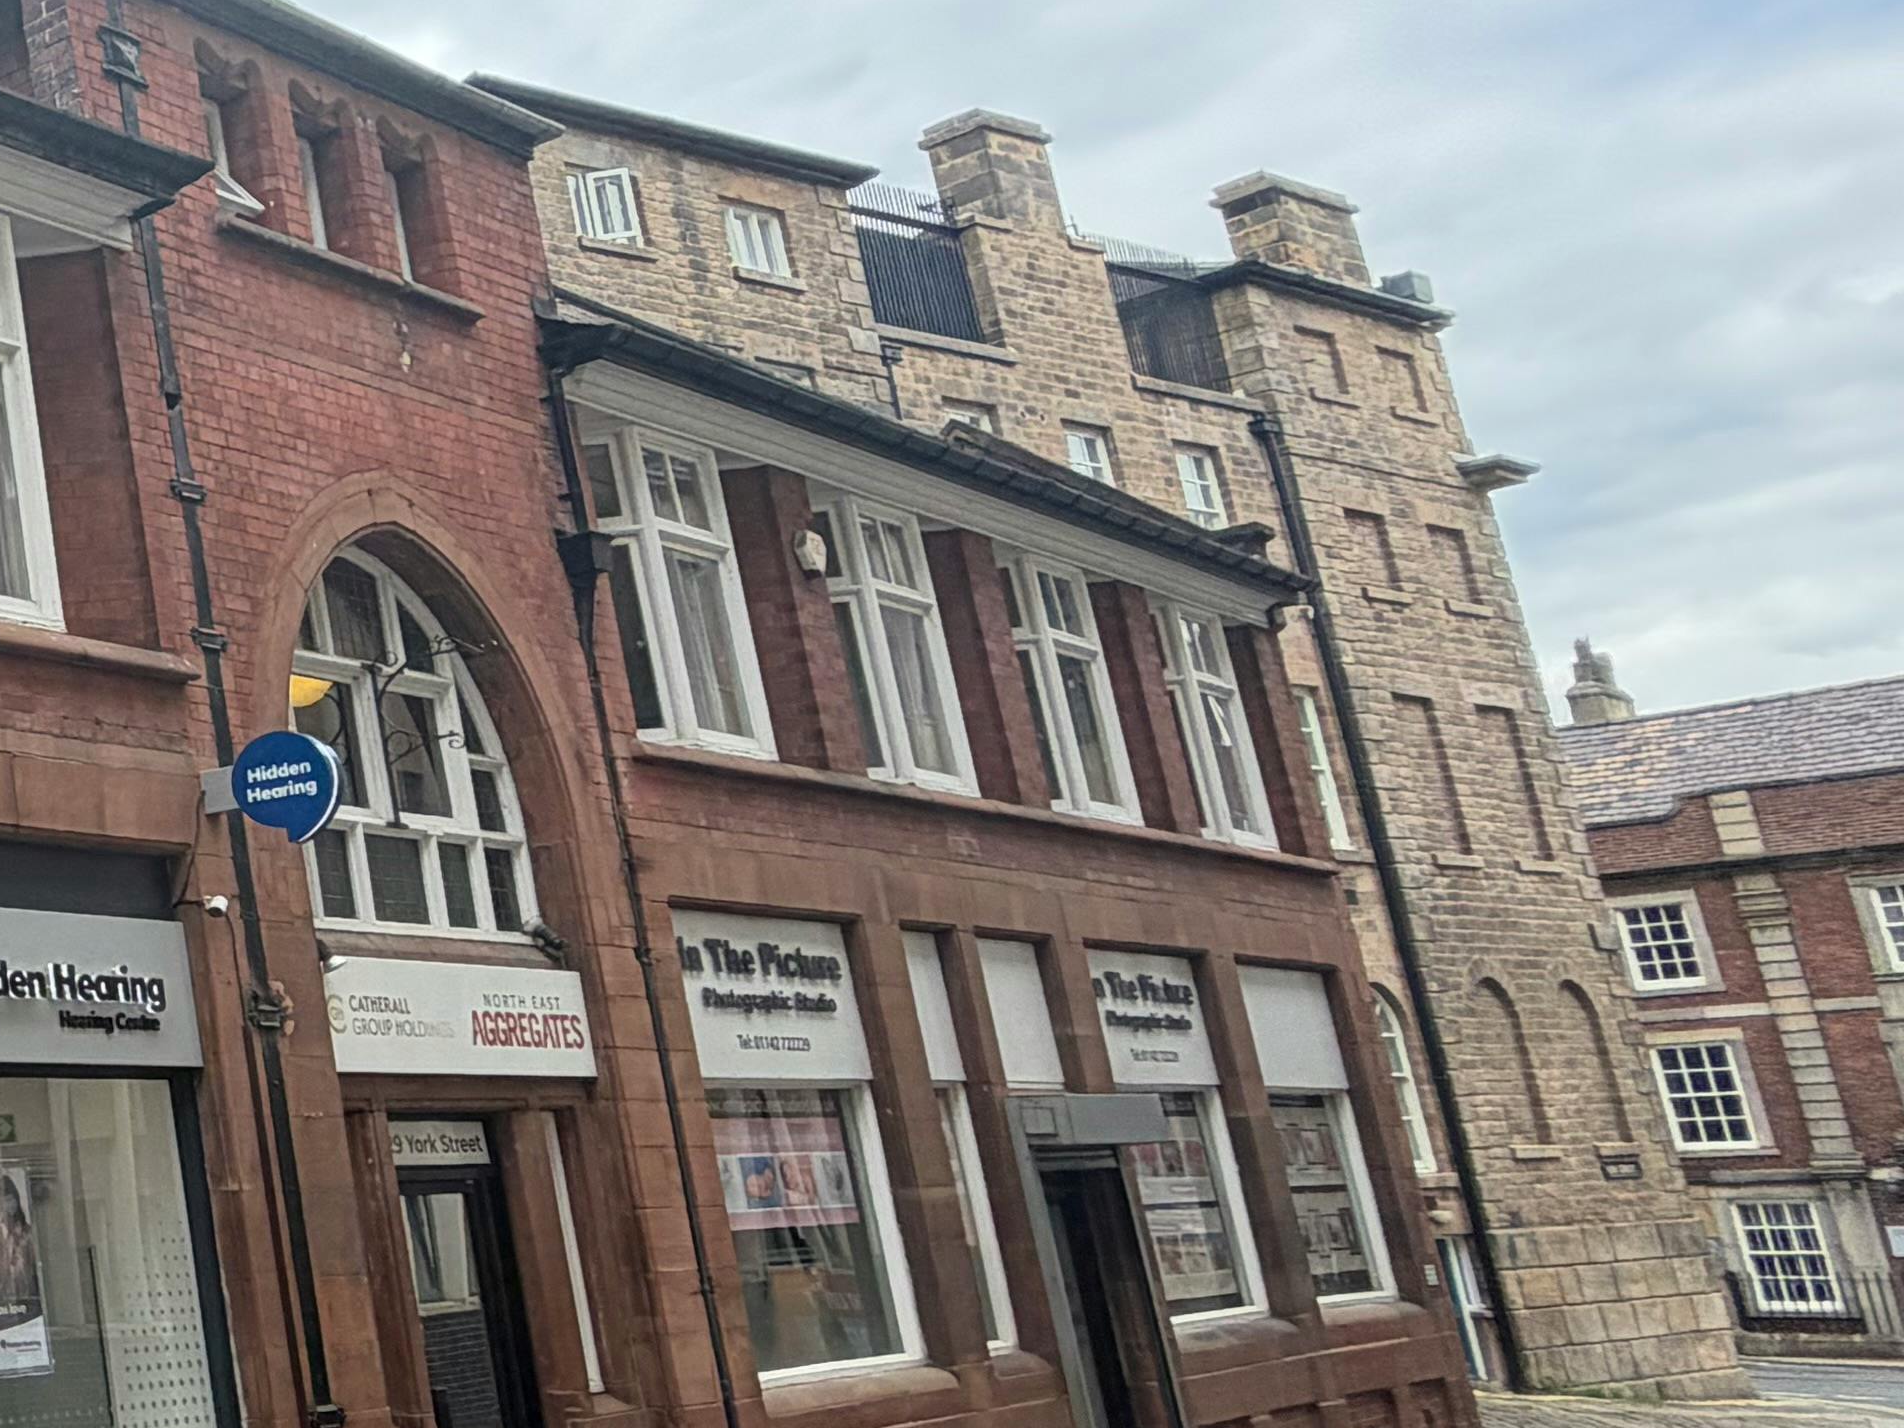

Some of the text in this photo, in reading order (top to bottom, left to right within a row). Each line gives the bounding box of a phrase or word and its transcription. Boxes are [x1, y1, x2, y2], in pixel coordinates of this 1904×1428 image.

[247, 762, 312, 784] Hidden
[247, 780, 318, 803] Hearing
[676, 936, 843, 981] In The Picture
[48, 962, 167, 1014] Hearing
[1092, 978, 1106, 998] n
[1103, 971, 1139, 1001] The
[348, 994, 412, 1015] CATHERALL
[483, 993, 561, 1010] NORTH EAST
[58, 1009, 114, 1035] Hearing
[352, 1017, 393, 1036] GROUP
[471, 1009, 585, 1050] AGGREGATES
[404, 1133, 440, 1154] York
[439, 1133, 484, 1154] Street
